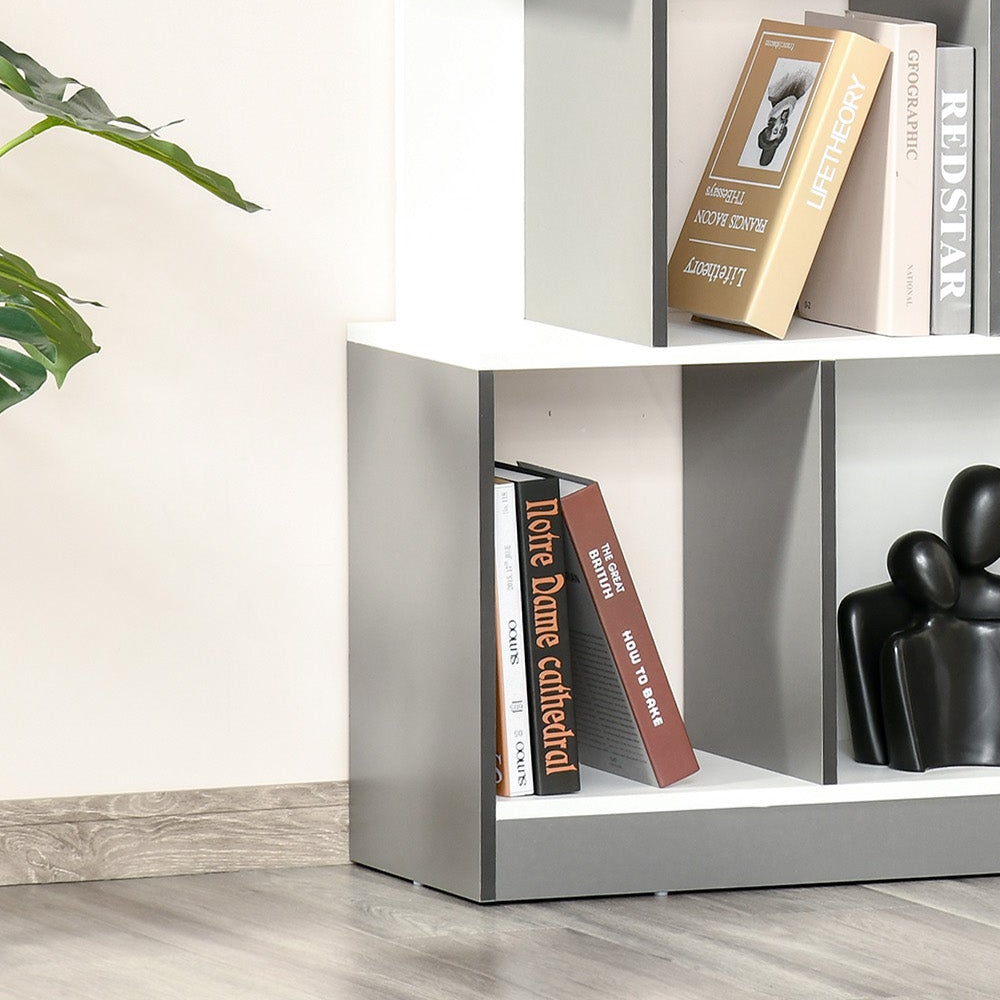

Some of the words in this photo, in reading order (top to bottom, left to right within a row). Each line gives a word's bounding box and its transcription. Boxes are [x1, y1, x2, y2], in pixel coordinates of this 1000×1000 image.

[805, 73, 866, 211] LIFETHEORY
[694, 209, 727, 229] BACON
[729, 211, 769, 234] FRANCIS
[940, 89, 968, 302] REDSTAR
[683, 257, 747, 288] Lifetheory
[905, 264, 914, 307] NATIONAL
[525, 498, 559, 568] Notre
[588, 547, 613, 601] BRITISH
[600, 542, 613, 563] THE
[607, 561, 626, 594] GREAT
[532, 571, 565, 650] Dame
[621, 630, 641, 665] HOW
[635, 666, 649, 685] TO
[643, 687, 663, 729] BAKE
[537, 656, 578, 777] cathedral
